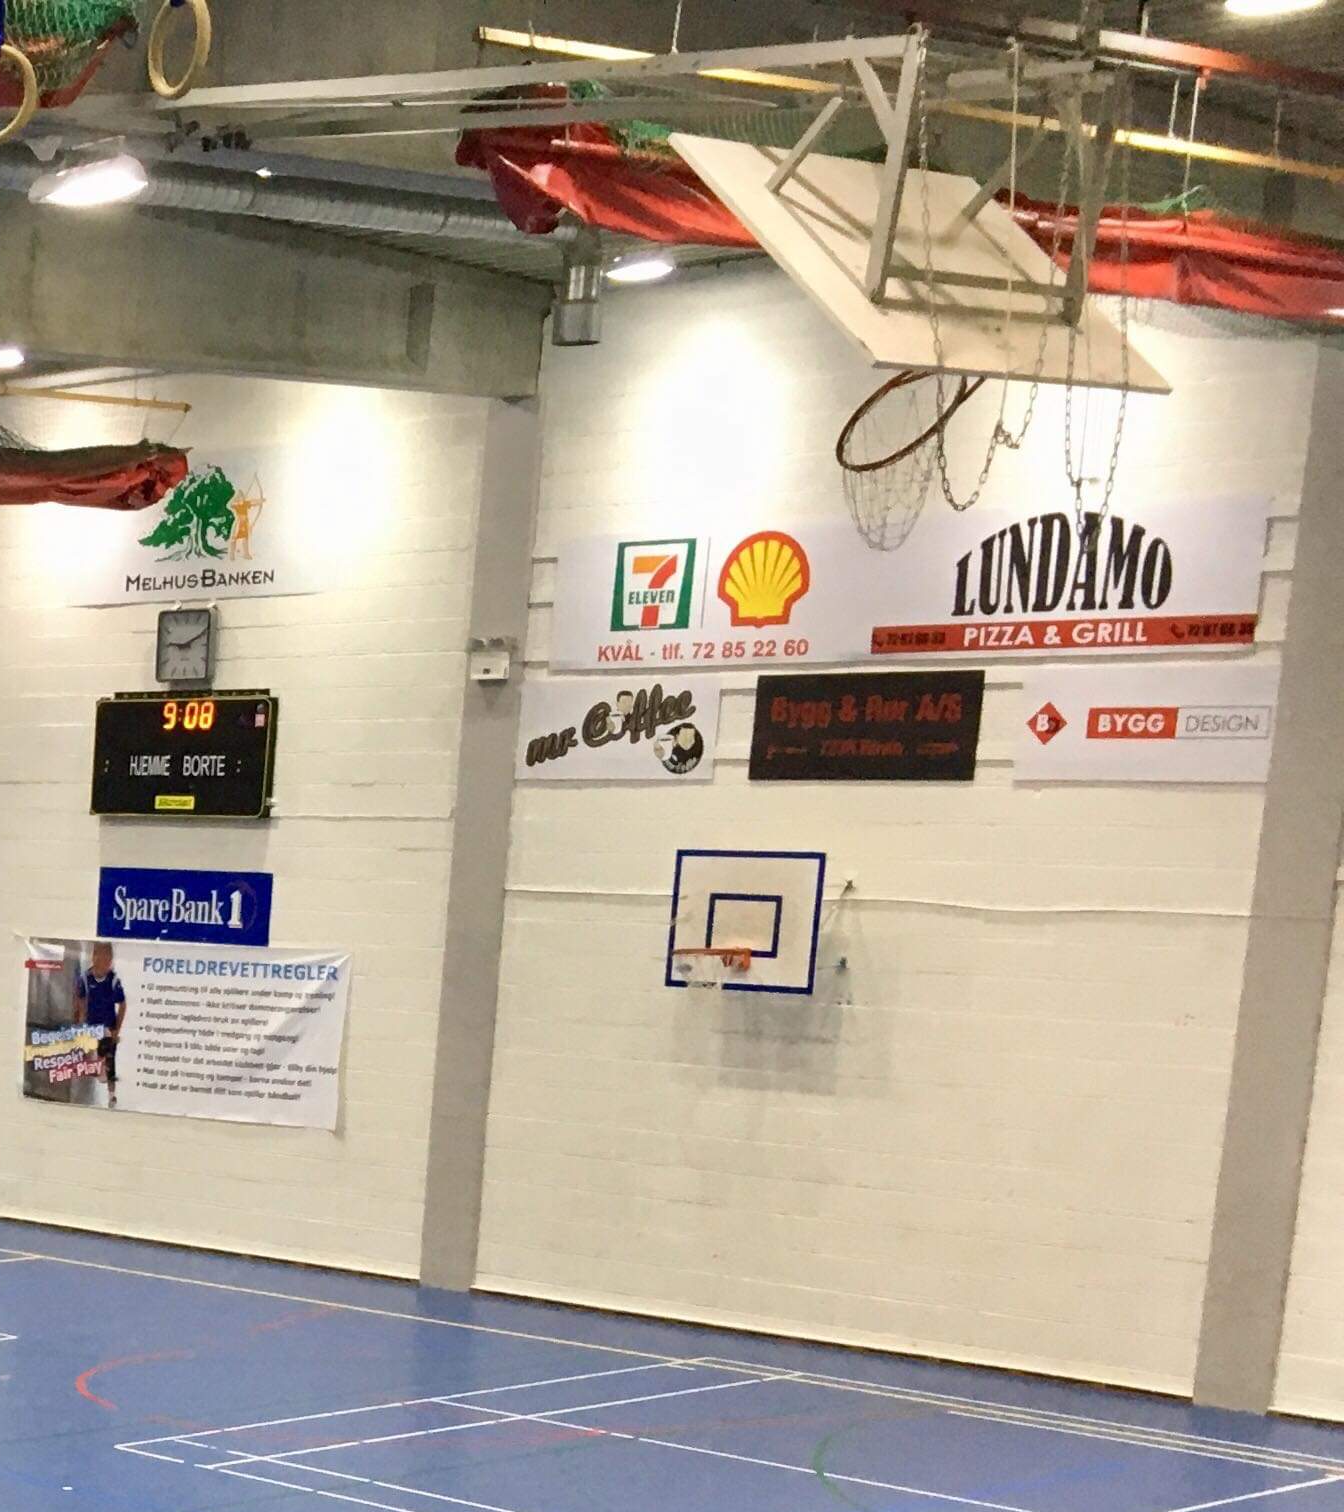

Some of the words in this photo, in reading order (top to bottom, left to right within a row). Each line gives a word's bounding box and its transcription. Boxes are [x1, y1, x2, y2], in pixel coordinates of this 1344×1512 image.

[951, 511, 1172, 617] LUNDAMO
[964, 625, 1034, 647] PIZZA
[1043, 625, 1061, 645] &
[1071, 621, 1147, 644] GRILL
[598, 639, 644, 662] KVÅL
[692, 643, 715, 659] 72
[721, 641, 745, 659] 85
[752, 640, 776, 657] 22
[784, 639, 809, 656] 60
[163, 700, 215, 730] 9:08
[1097, 713, 1165, 733] BYGG
[1185, 714, 1259, 733] DESIGN
[182, 755, 226, 776] BORTE
[227, 890, 243, 929] 1
[143, 957, 339, 981] FORELDREVETTREGLER
[31, 1024, 105, 1045] Begeistring
[34, 1049, 85, 1071] Respekt
[49, 1065, 73, 1083] Fair
[77, 1060, 103, 1078] Play
